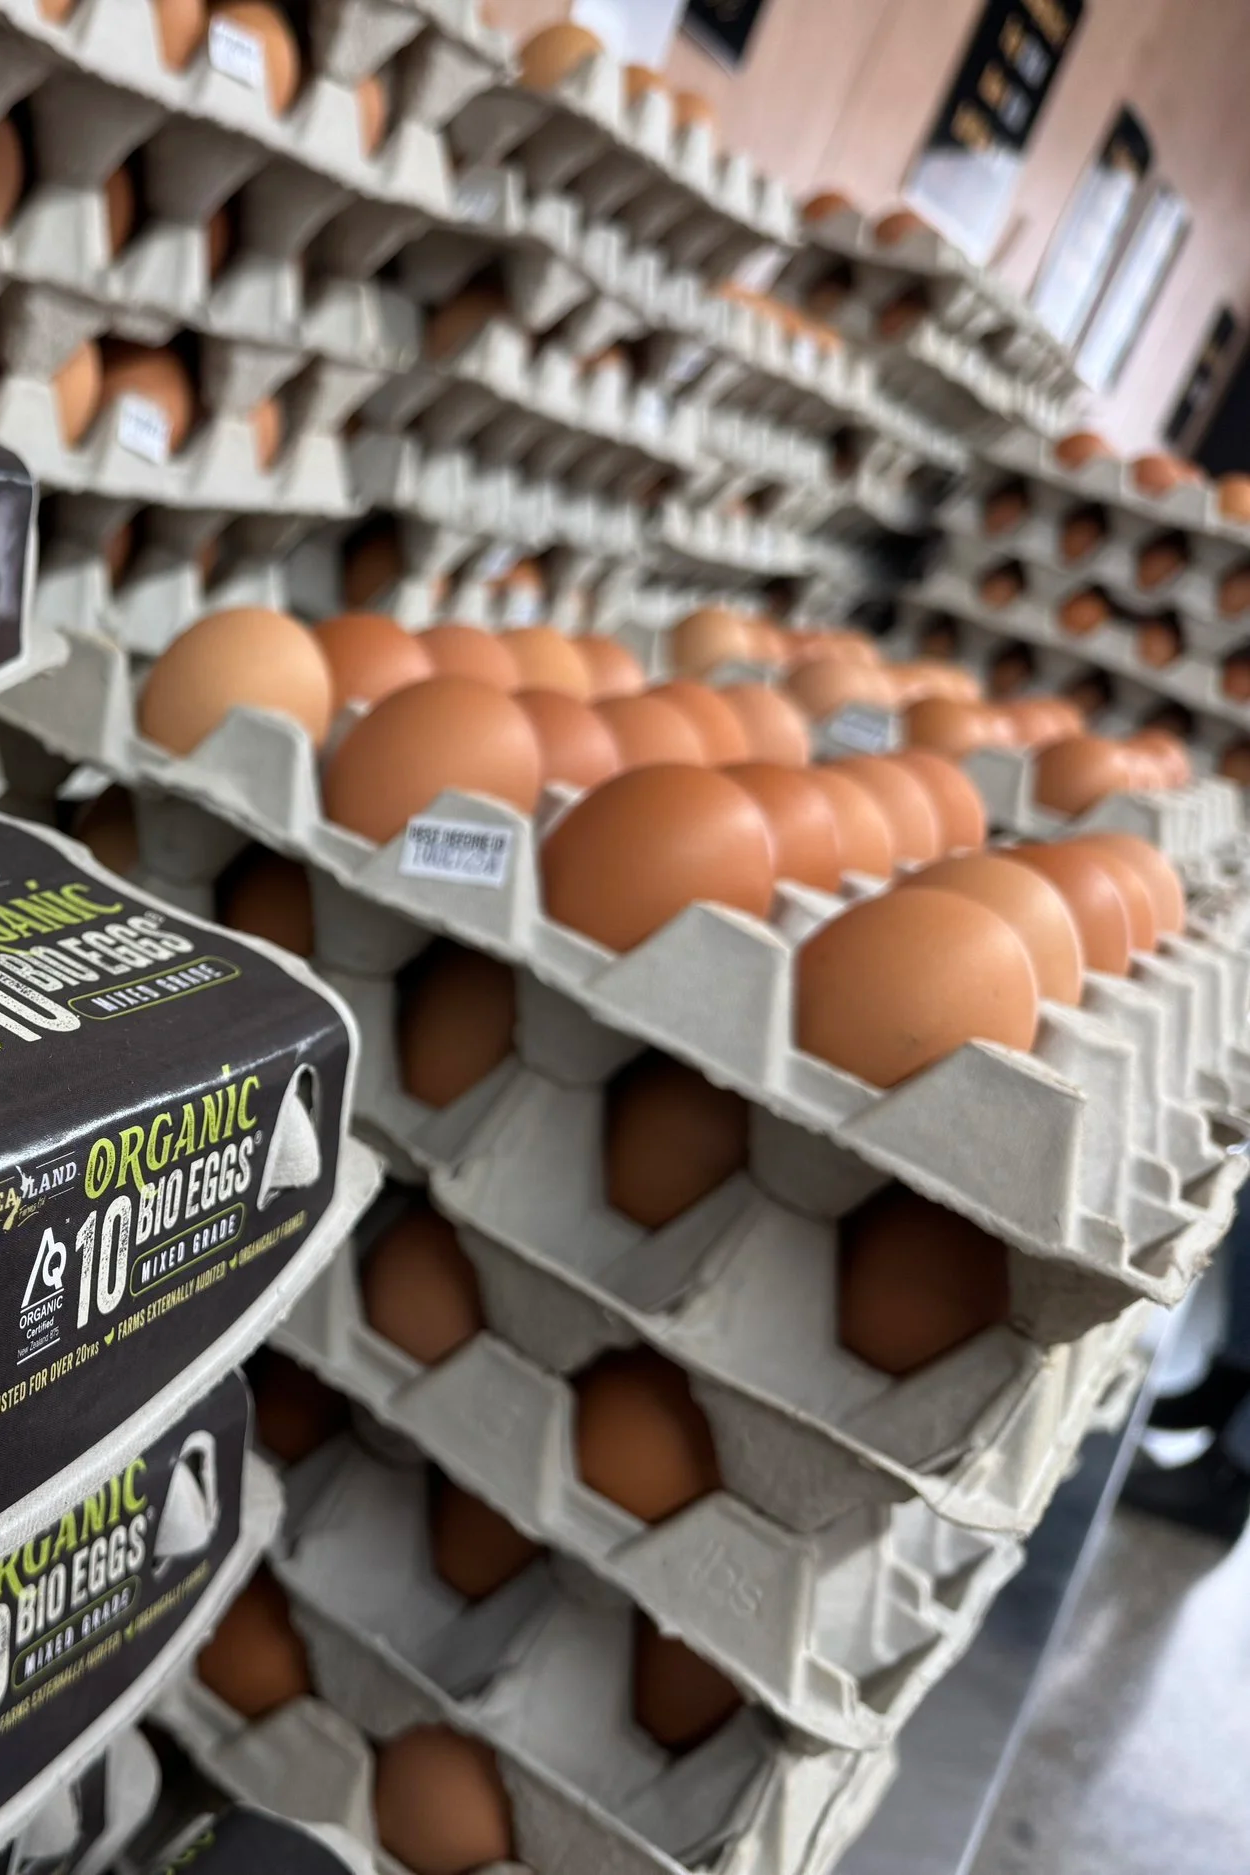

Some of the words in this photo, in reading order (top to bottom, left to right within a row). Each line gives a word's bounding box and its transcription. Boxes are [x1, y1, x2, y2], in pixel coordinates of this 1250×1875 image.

[91, 983, 161, 1013] MIXED
[156, 962, 224, 992] GRADE
[84, 1064, 262, 1200] ORGANIC
[74, 1194, 132, 1330] 10
[135, 1168, 183, 1247] BIO
[141, 1240, 186, 1285] MIXED
[192, 1213, 237, 1255] GRADE
[19, 1295, 63, 1330] ORGANIC
[26, 1316, 54, 1340] Certified
[117, 1308, 146, 1342] FARMS
[146, 1282, 195, 1323] EXTERNALLY
[194, 1260, 228, 1294] AUDITED
[28, 1370, 49, 1396] FOR
[50, 1354, 74, 1383] OVER
[15, 1562, 67, 1649] BIO
